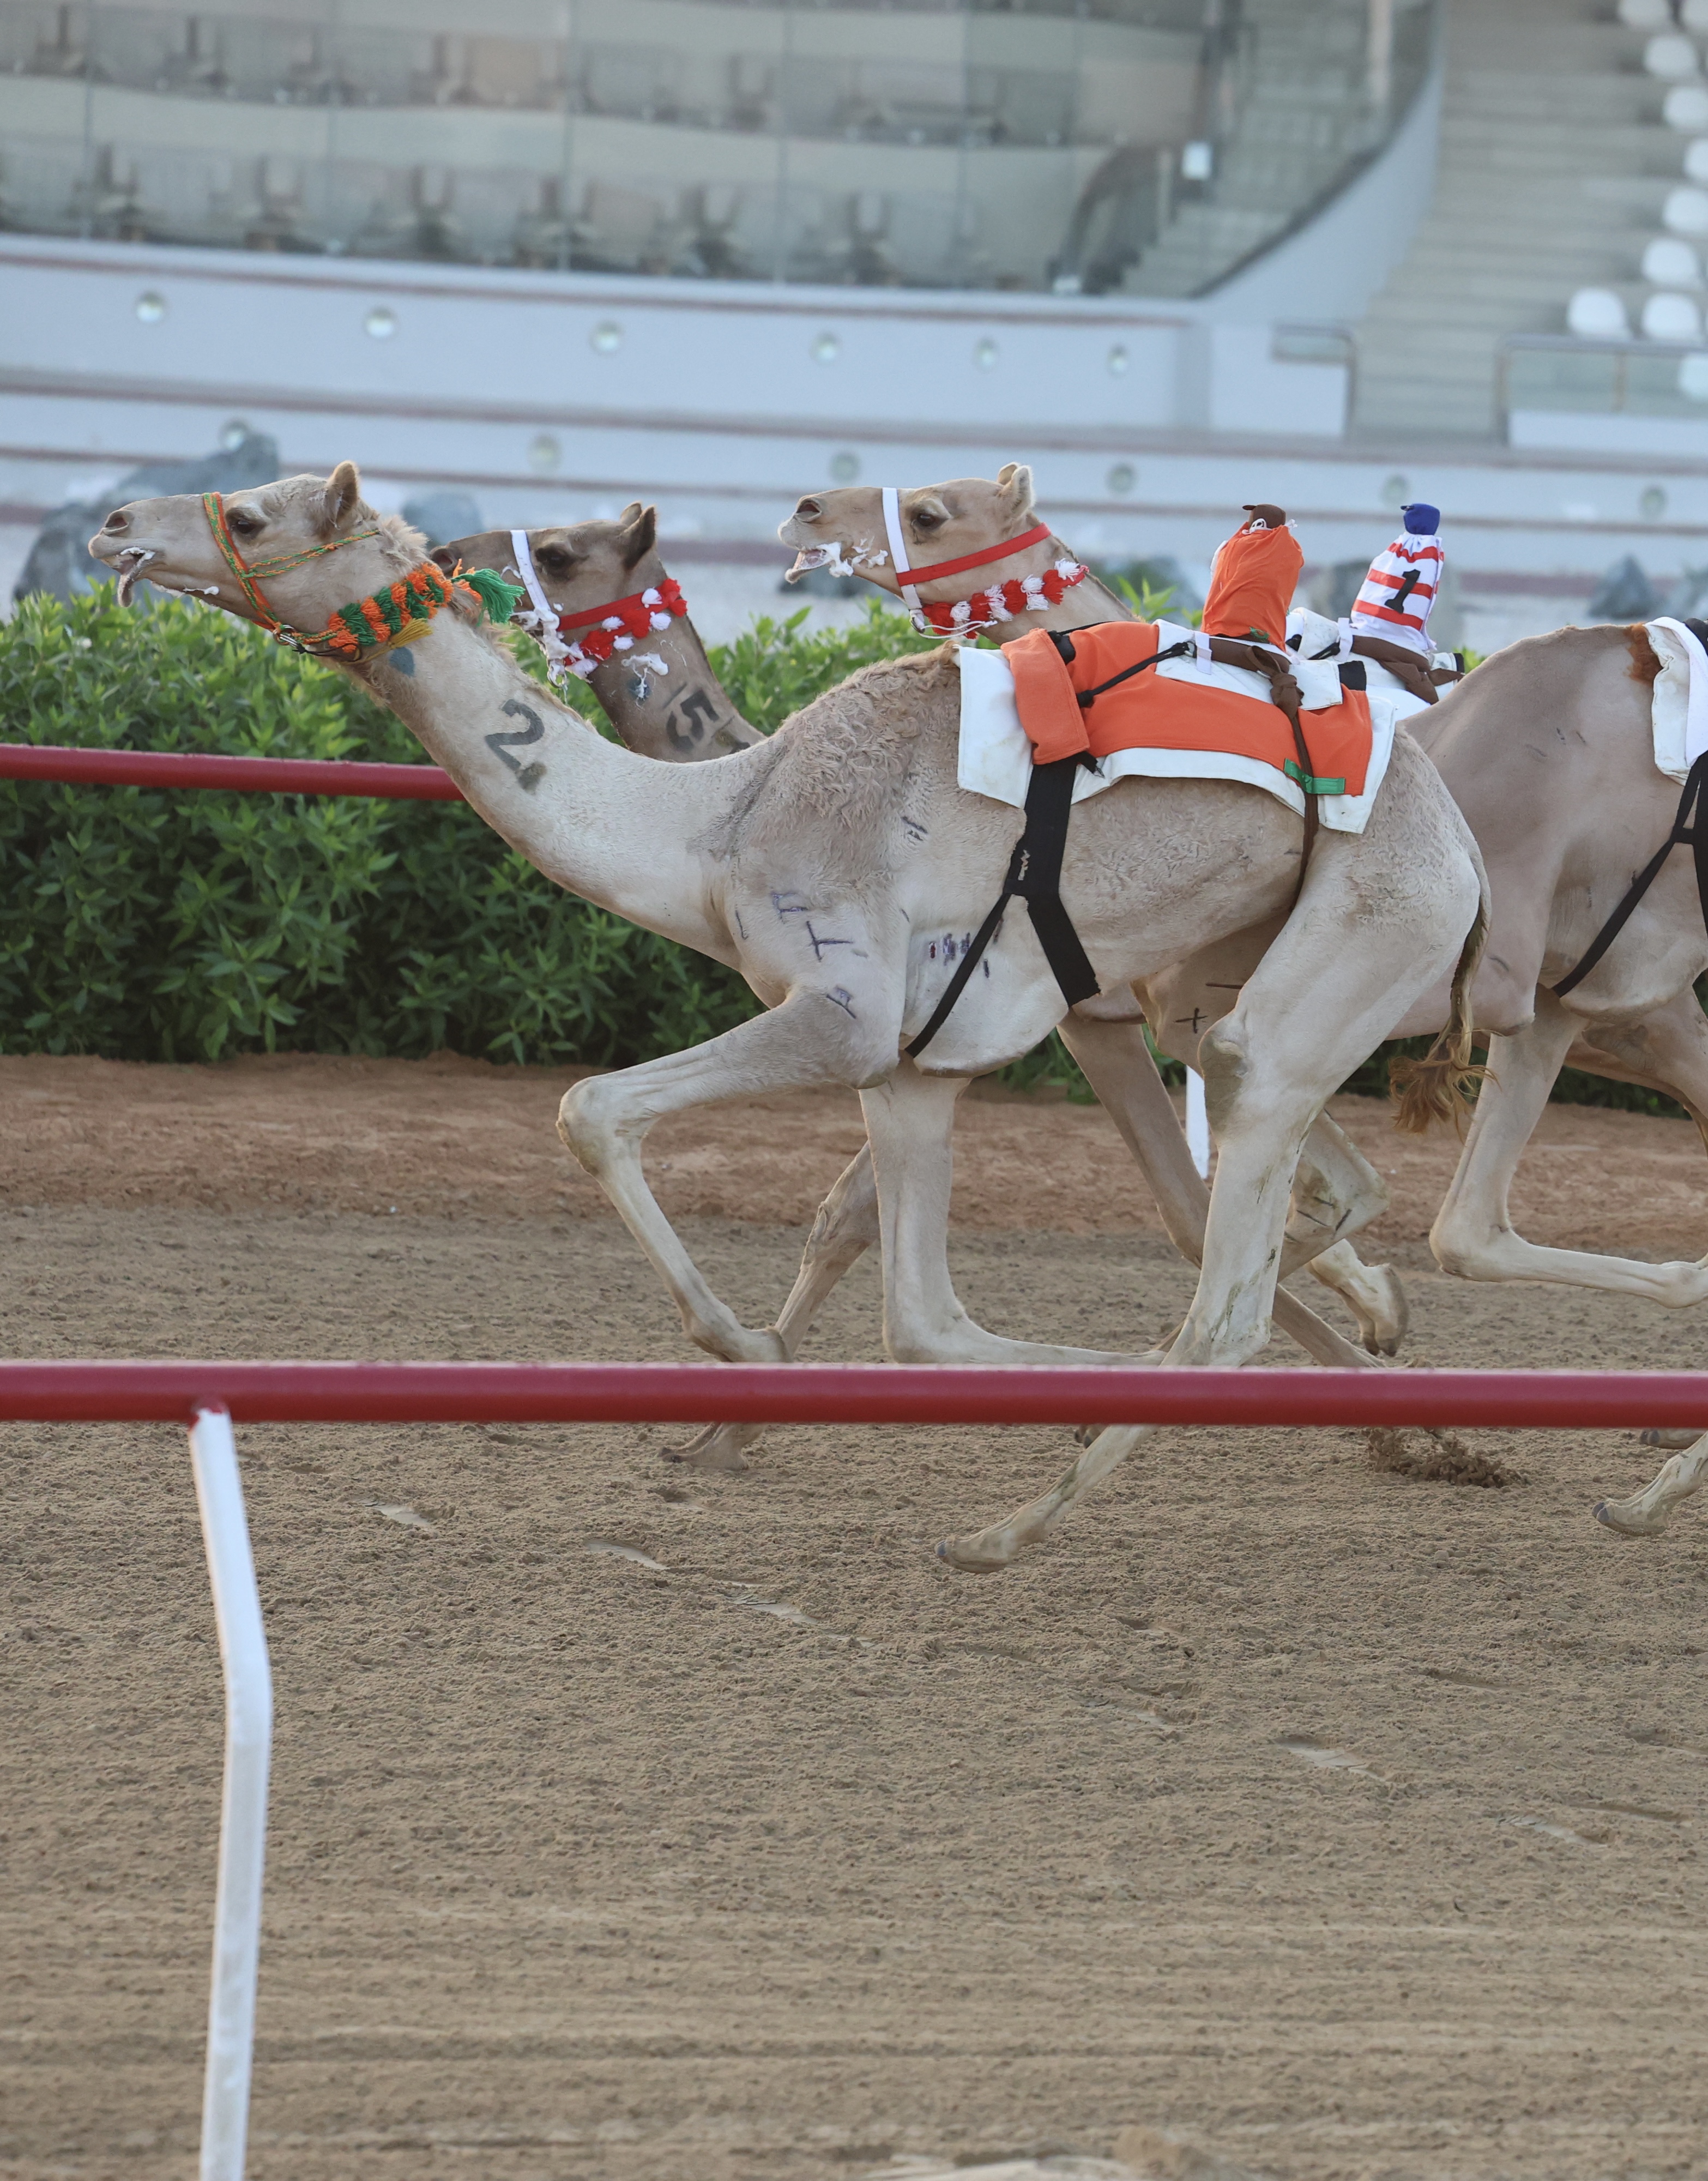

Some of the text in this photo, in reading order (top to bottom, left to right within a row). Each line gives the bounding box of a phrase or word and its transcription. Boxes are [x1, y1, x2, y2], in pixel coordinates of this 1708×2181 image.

[1384, 569, 1421, 614] 1
[485, 699, 545, 770] 2
[666, 689, 719, 752] 5
